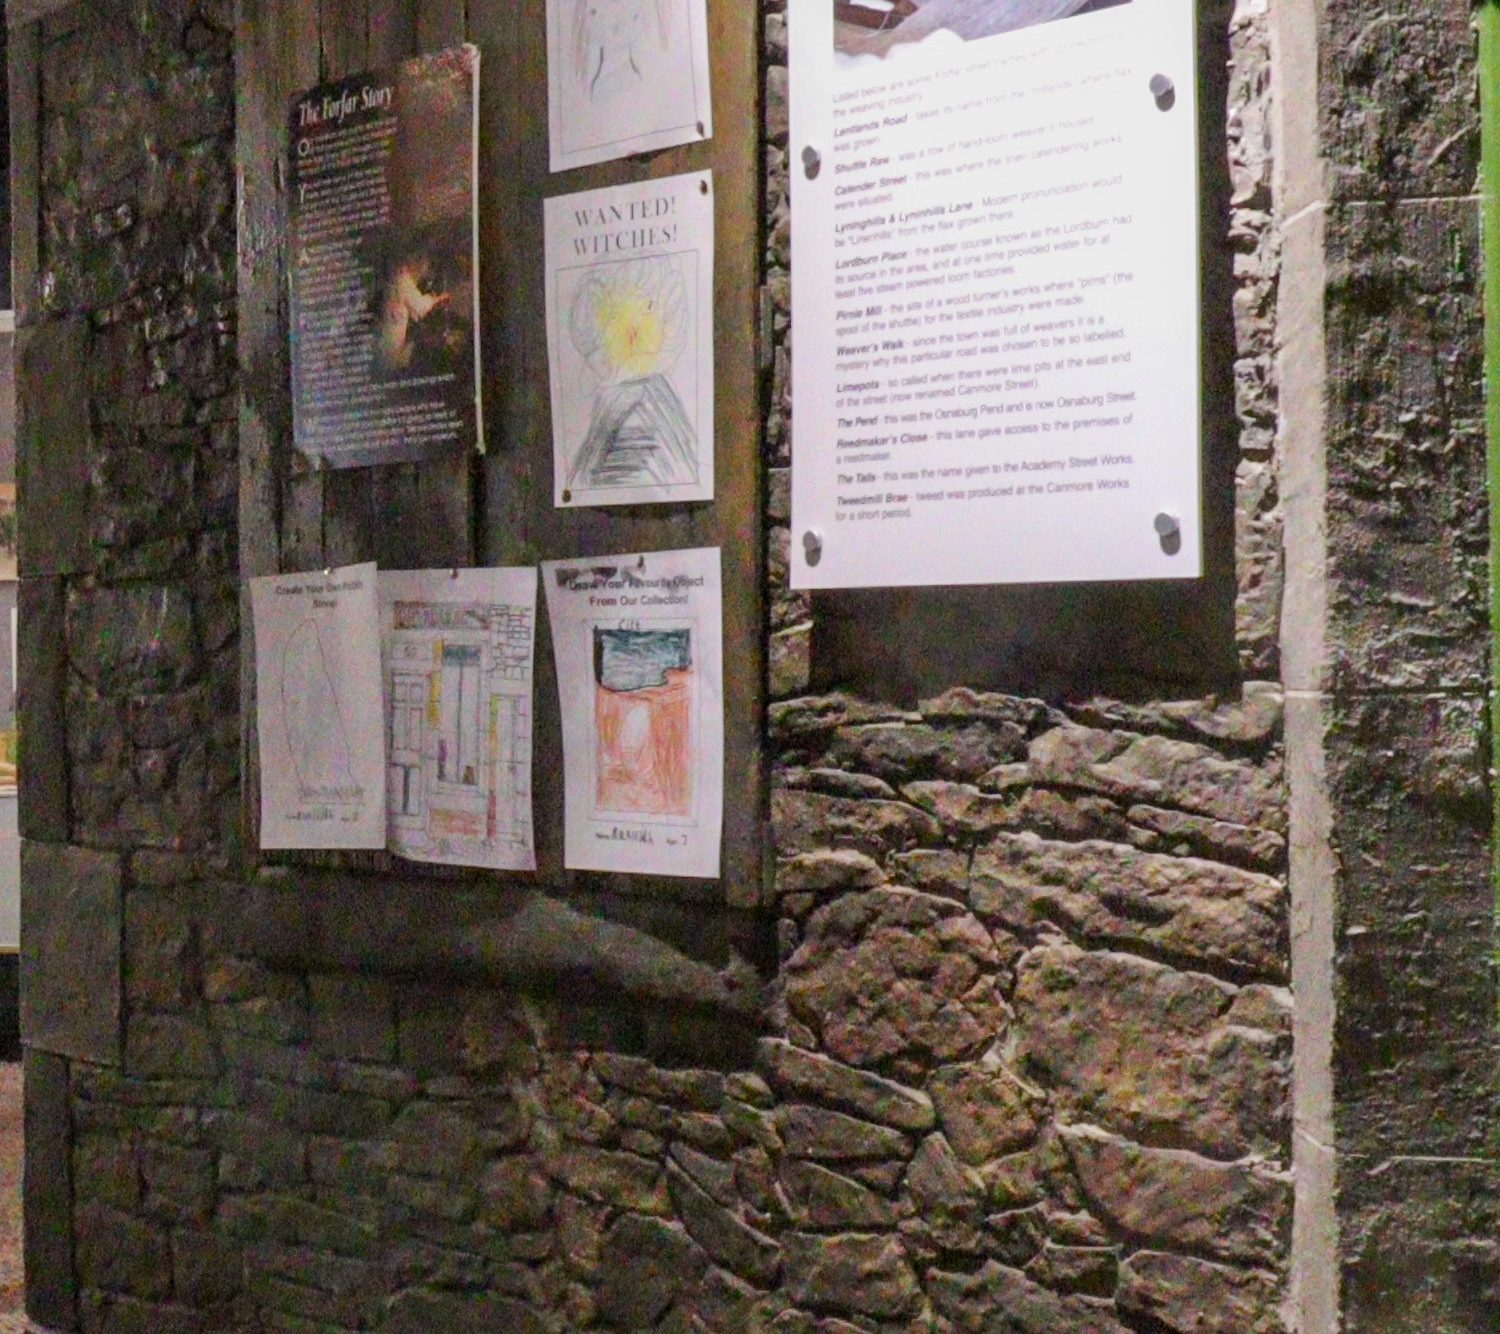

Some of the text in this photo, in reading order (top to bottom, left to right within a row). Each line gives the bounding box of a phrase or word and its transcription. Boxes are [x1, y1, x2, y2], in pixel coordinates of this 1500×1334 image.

[300, 86, 394, 127] The Forfar Story
[832, 113, 908, 138] Lentlands Road
[833, 160, 867, 174] Shuttle
[834, 181, 876, 196] Calender
[879, 174, 907, 187] Street
[575, 196, 676, 228] WANTED!
[573, 225, 678, 256] WITCHES!
[834, 213, 1132, 270] Lordburn Place water course known the Lordburn had
[835, 271, 1134, 320] Pirnie Mill site wood turner's works where (the
[834, 299, 1052, 337] spool shuttle) textile industry were
[881, 338, 904, 350] Walk
[912, 336, 936, 347] since
[938, 333, 954, 343] the
[955, 331, 979, 342] town
[981, 328, 1000, 338] was
[1002, 323, 1018, 336] full
[1032, 318, 1075, 331] weavers
[834, 339, 1037, 373] mystery why this particular road was chosen
[835, 350, 1131, 393] Limepots called when there were lime pits the east end
[836, 390, 1136, 427] The Pend was Osnaburg Pend and now Osnaburg Street.
[862, 383, 1002, 405] street (now renamed Canmore
[835, 416, 1120, 449] Reedmaker's Close this lane gave access the premises
[837, 454, 1134, 484] The this was name given Academy Street Works.
[842, 451, 892, 463] reedmaker.
[836, 493, 883, 506] Tweedmill
[915, 490, 944, 501] tweed
[945, 490, 965, 499] was
[967, 484, 1013, 500] produced
[1027, 484, 1044, 494] the
[1045, 481, 1094, 493] Canmore
[1096, 478, 1130, 489] Works
[856, 506, 912, 521] short period.
[589, 595, 617, 606] From
[620, 595, 637, 605] Our
